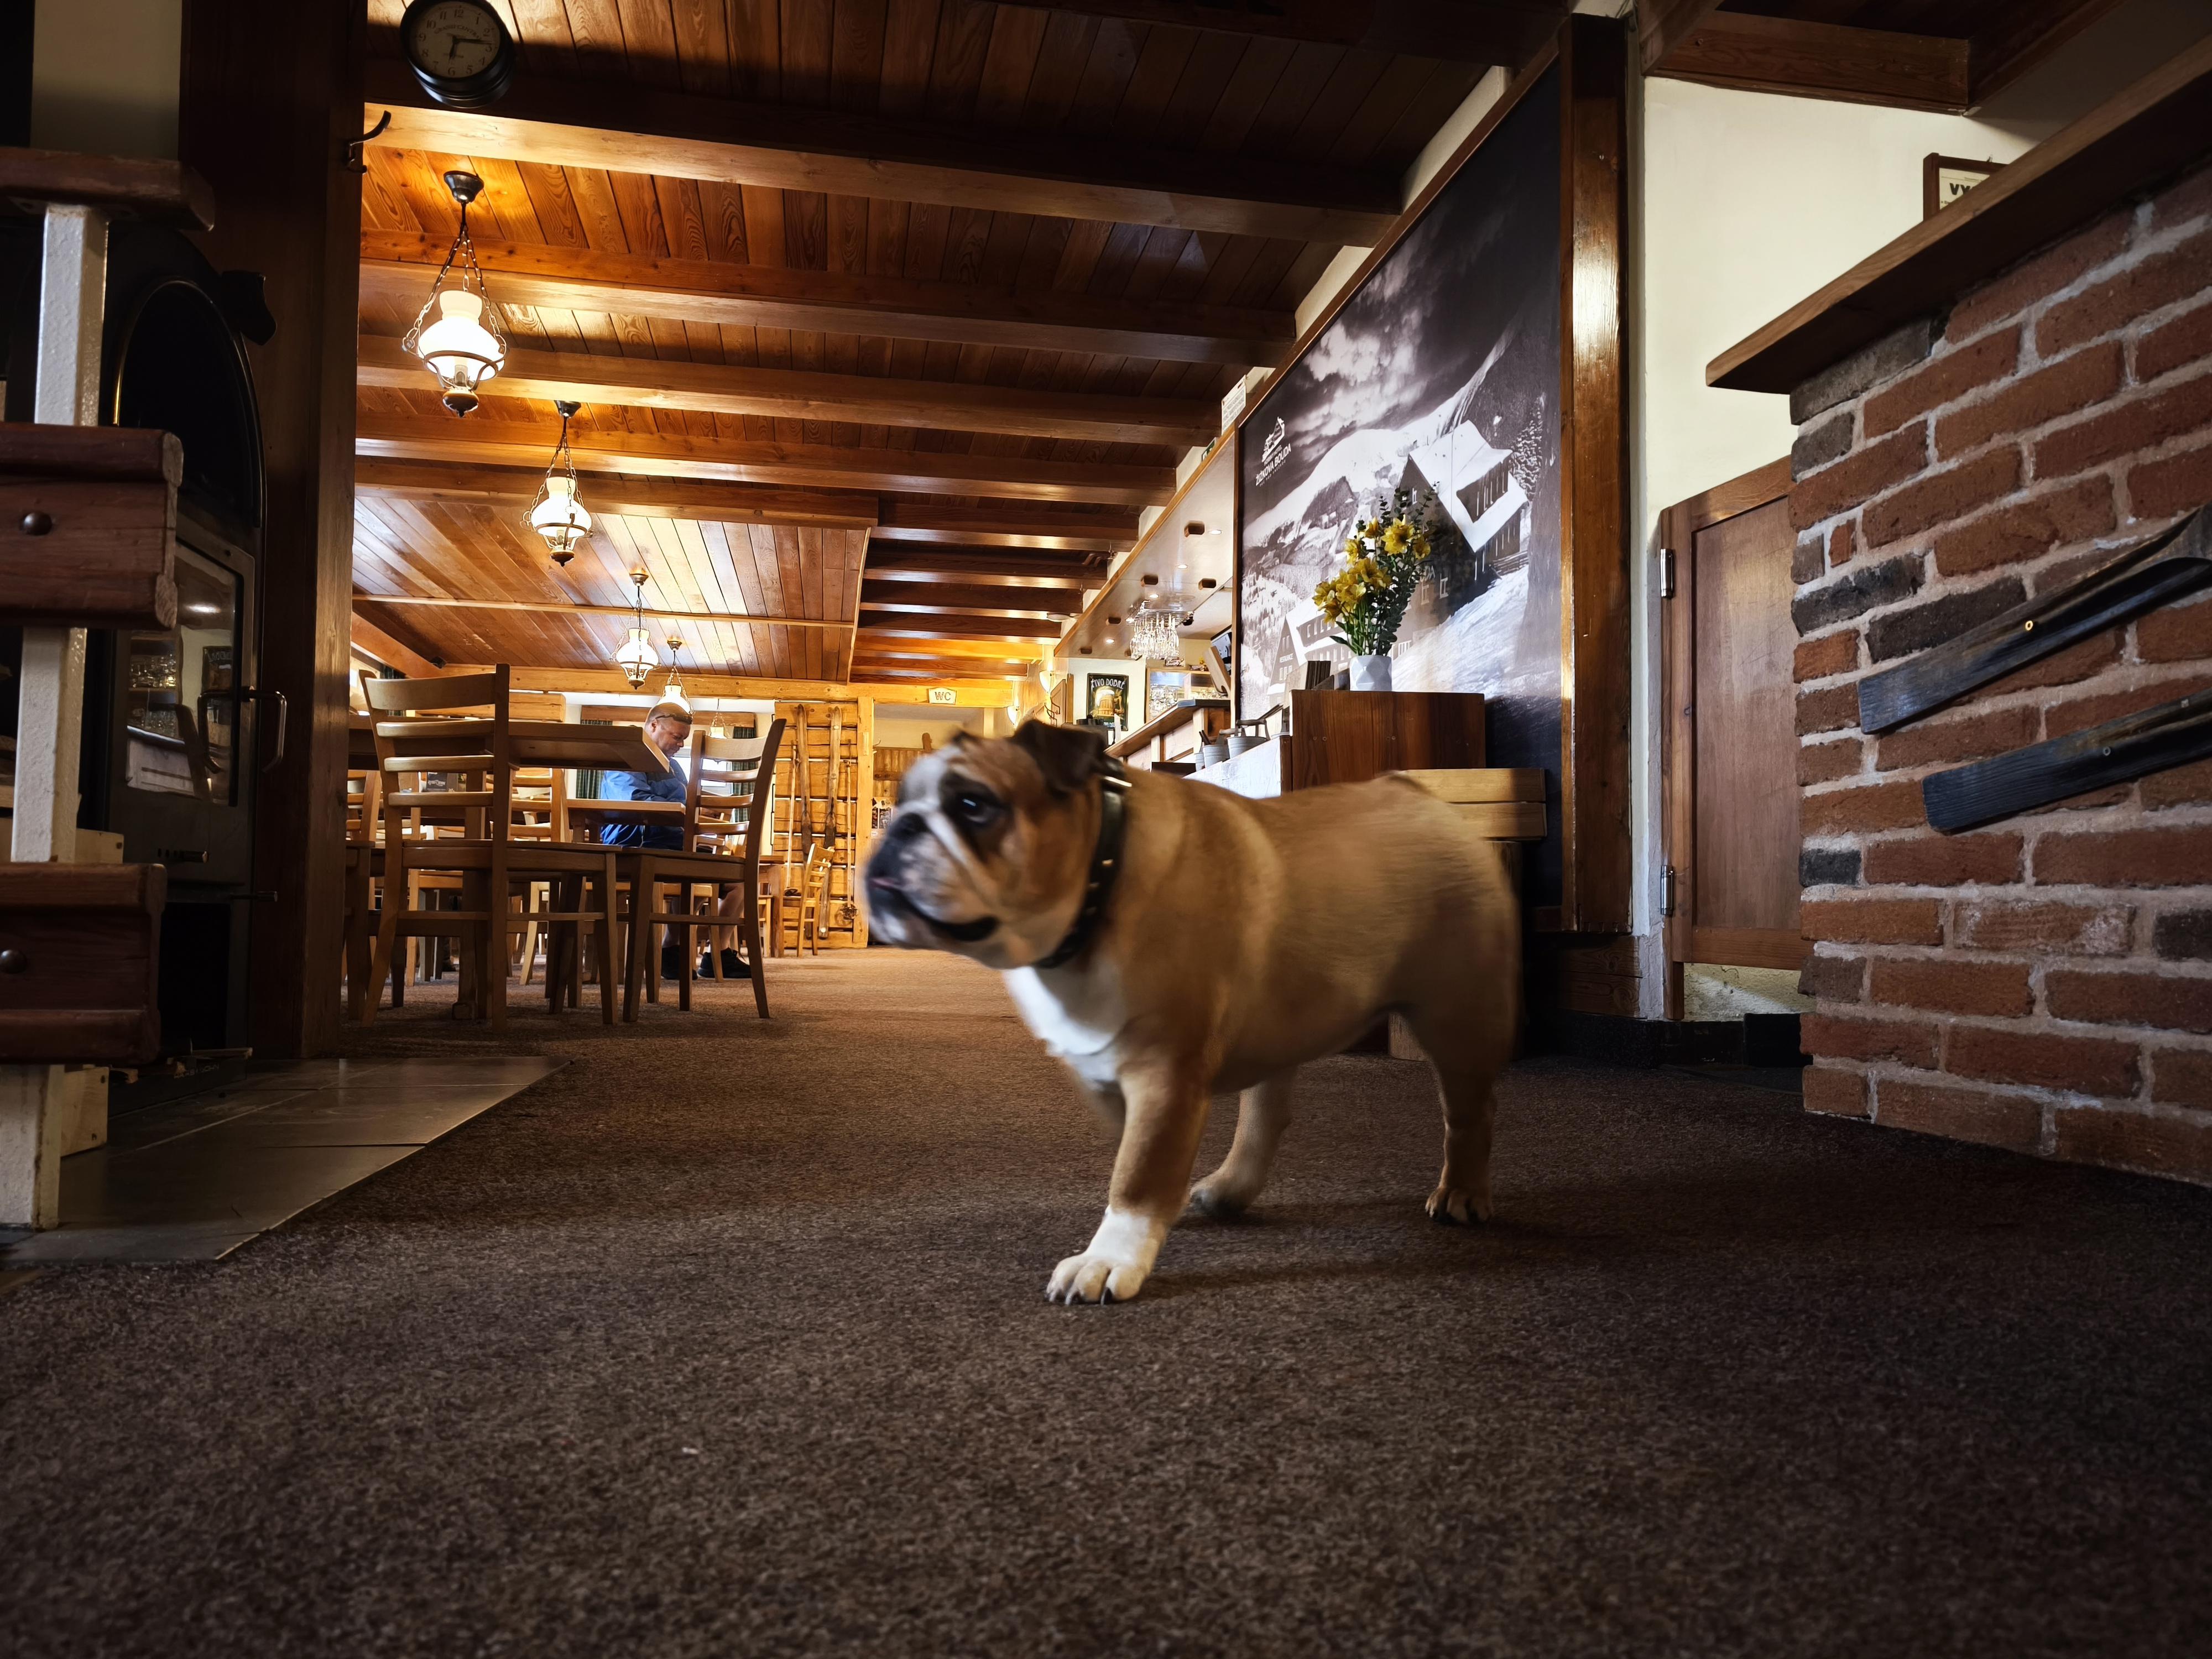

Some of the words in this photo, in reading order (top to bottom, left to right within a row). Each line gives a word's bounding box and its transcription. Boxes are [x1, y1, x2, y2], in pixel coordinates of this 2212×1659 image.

[440, 11, 447, 20] 11
[454, 9, 464, 18] 12
[426, 19, 436, 29] 10
[482, 28, 490, 36] 2
[419, 33, 426, 41] 9
[422, 49, 429, 57] 8
[486, 44, 492, 53] 3
[479, 56, 486, 66] 4
[433, 61, 439, 71] 7
[466, 64, 473, 74] 5
[448, 66, 455, 76] 6
[1274, 443, 1291, 467] BOUDA
[1106, 679, 1125, 690] DOBRÉ
[935, 692, 951, 701] WC
